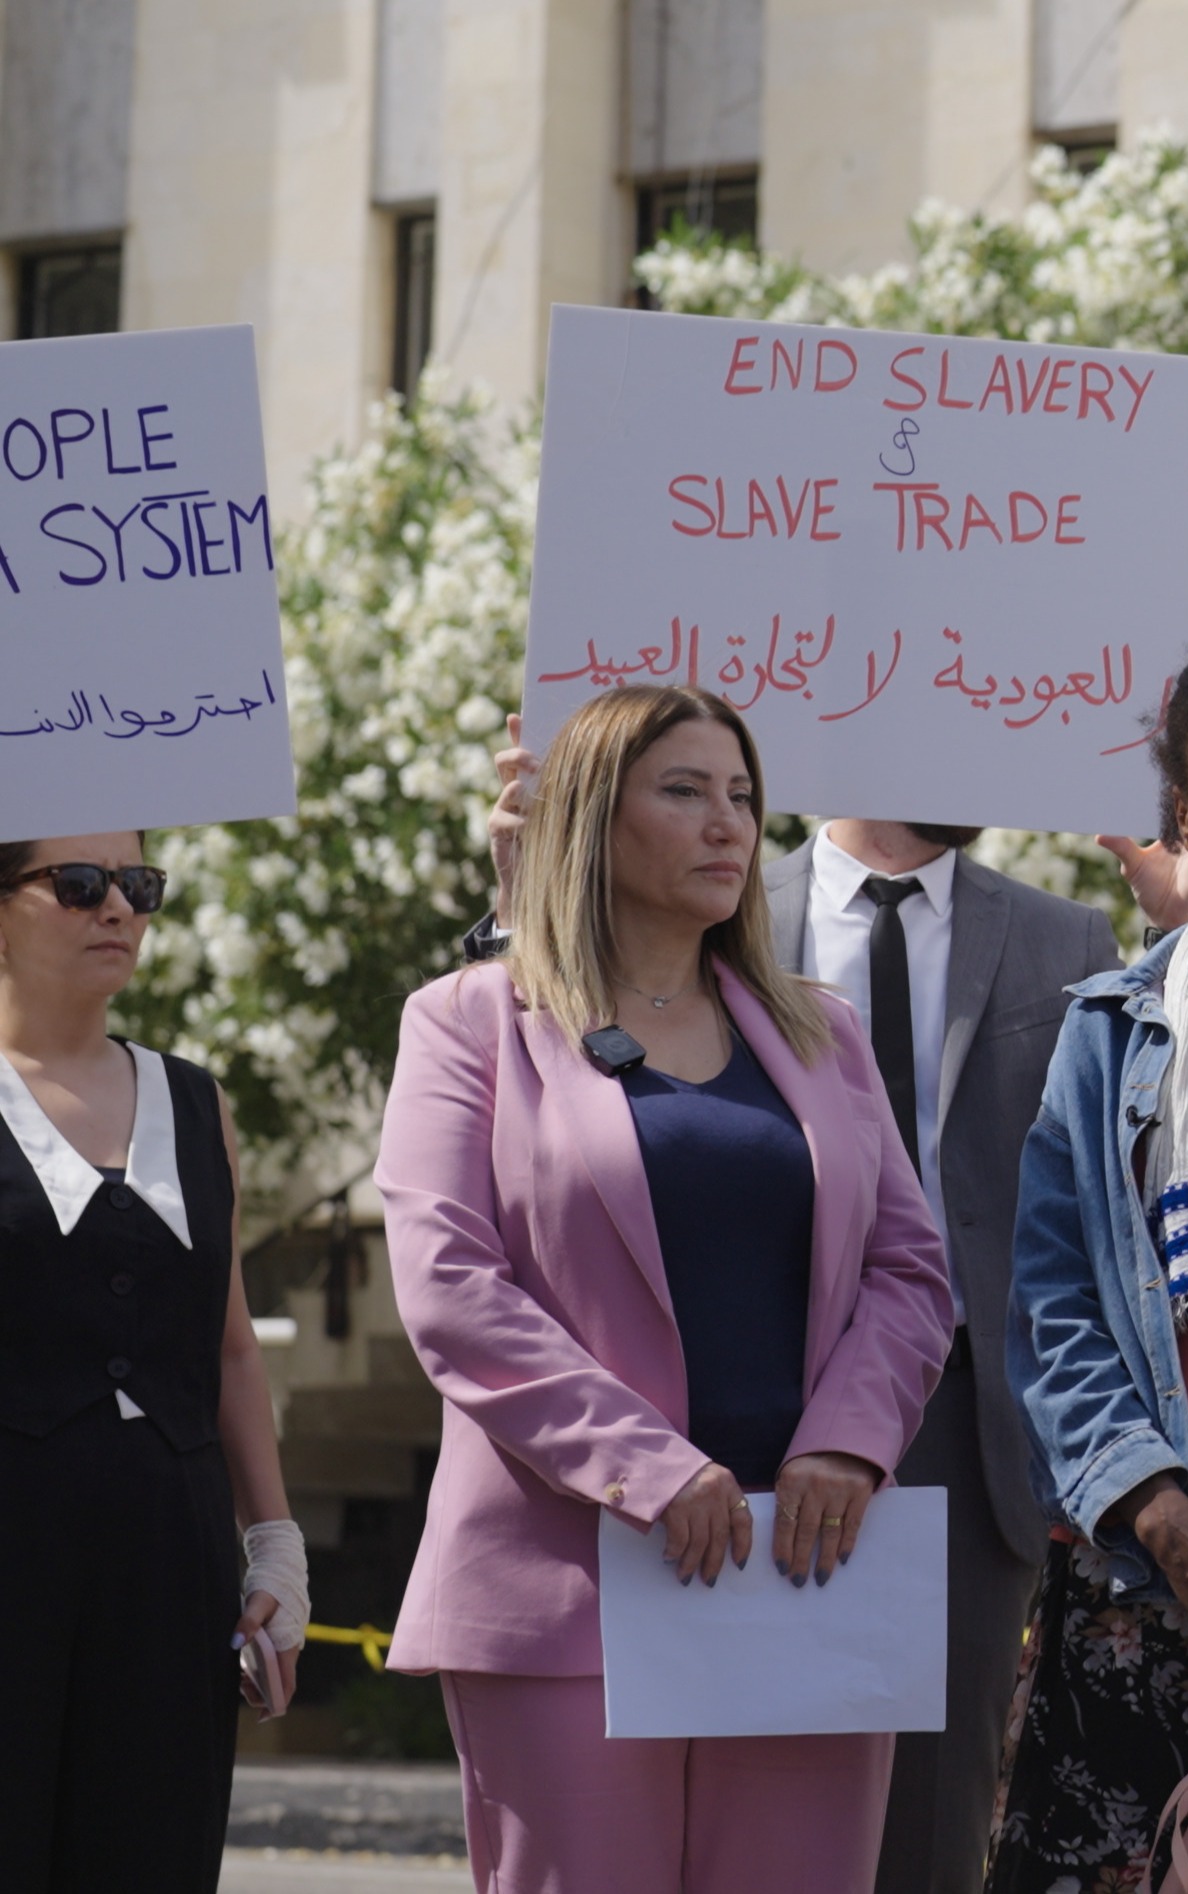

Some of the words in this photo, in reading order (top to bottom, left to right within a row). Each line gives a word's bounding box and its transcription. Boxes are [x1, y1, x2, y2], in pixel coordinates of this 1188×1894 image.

[725, 337, 857, 395] END
[883, 345, 1155, 432] SLAVERY
[40, 490, 274, 587] SYSTEM
[669, 475, 841, 541] SLAVE
[873, 483, 1086, 552] TRADE
[537, 616, 698, 687] العبيد
[718, 613, 835, 712] لتجارة
[818, 628, 901, 721] لا
[934, 626, 1132, 728] للعبودية
[99, 669, 275, 739] احترموا
